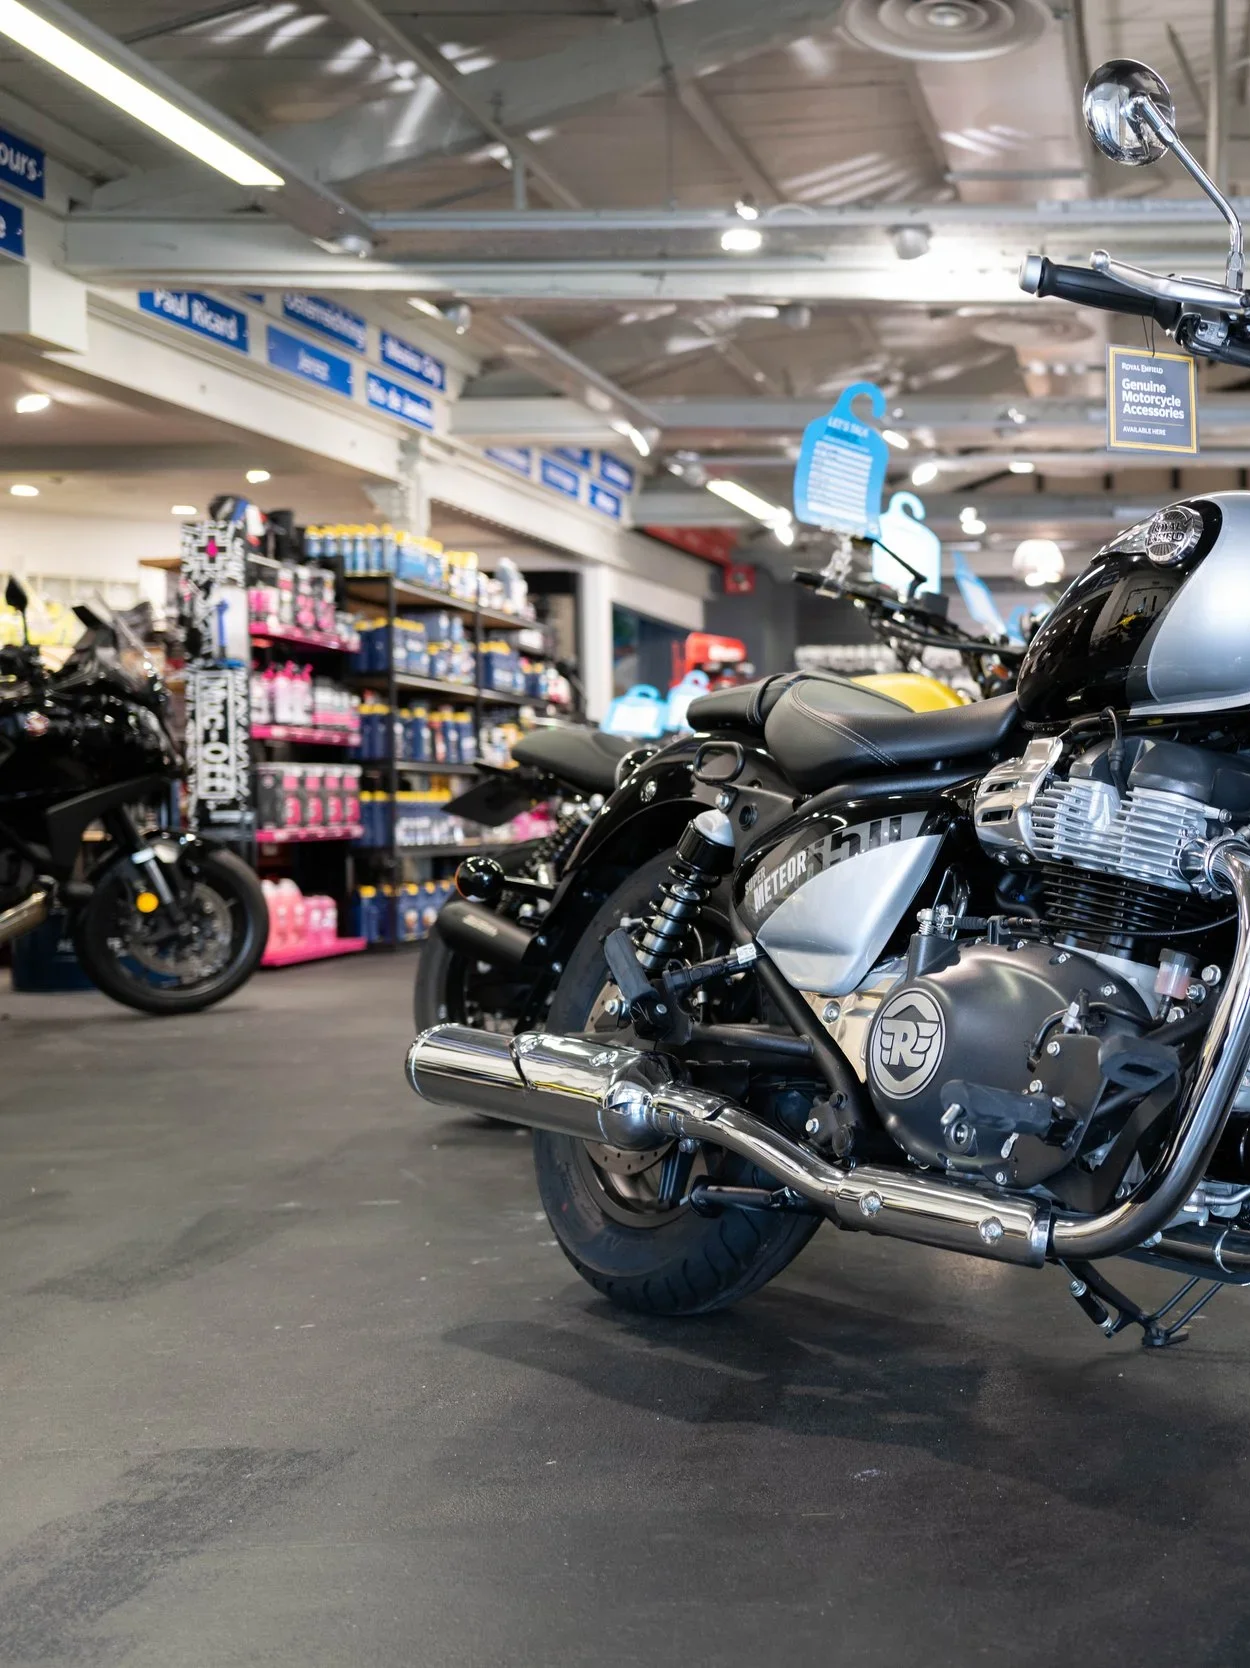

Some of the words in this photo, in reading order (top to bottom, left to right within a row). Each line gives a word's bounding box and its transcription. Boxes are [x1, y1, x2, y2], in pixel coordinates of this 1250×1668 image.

[1121, 362, 1141, 373] ROYAL
[1141, 364, 1164, 375] ENFIELD
[1121, 378, 1167, 394] Genuine
[1121, 390, 1182, 408] Motorcycle
[1122, 403, 1185, 420] Accessories
[1122, 425, 1152, 435] AVAILABLE
[1151, 428, 1167, 436] HERE
[744, 865, 767, 896] SUPER
[753, 849, 808, 914] METEOR
